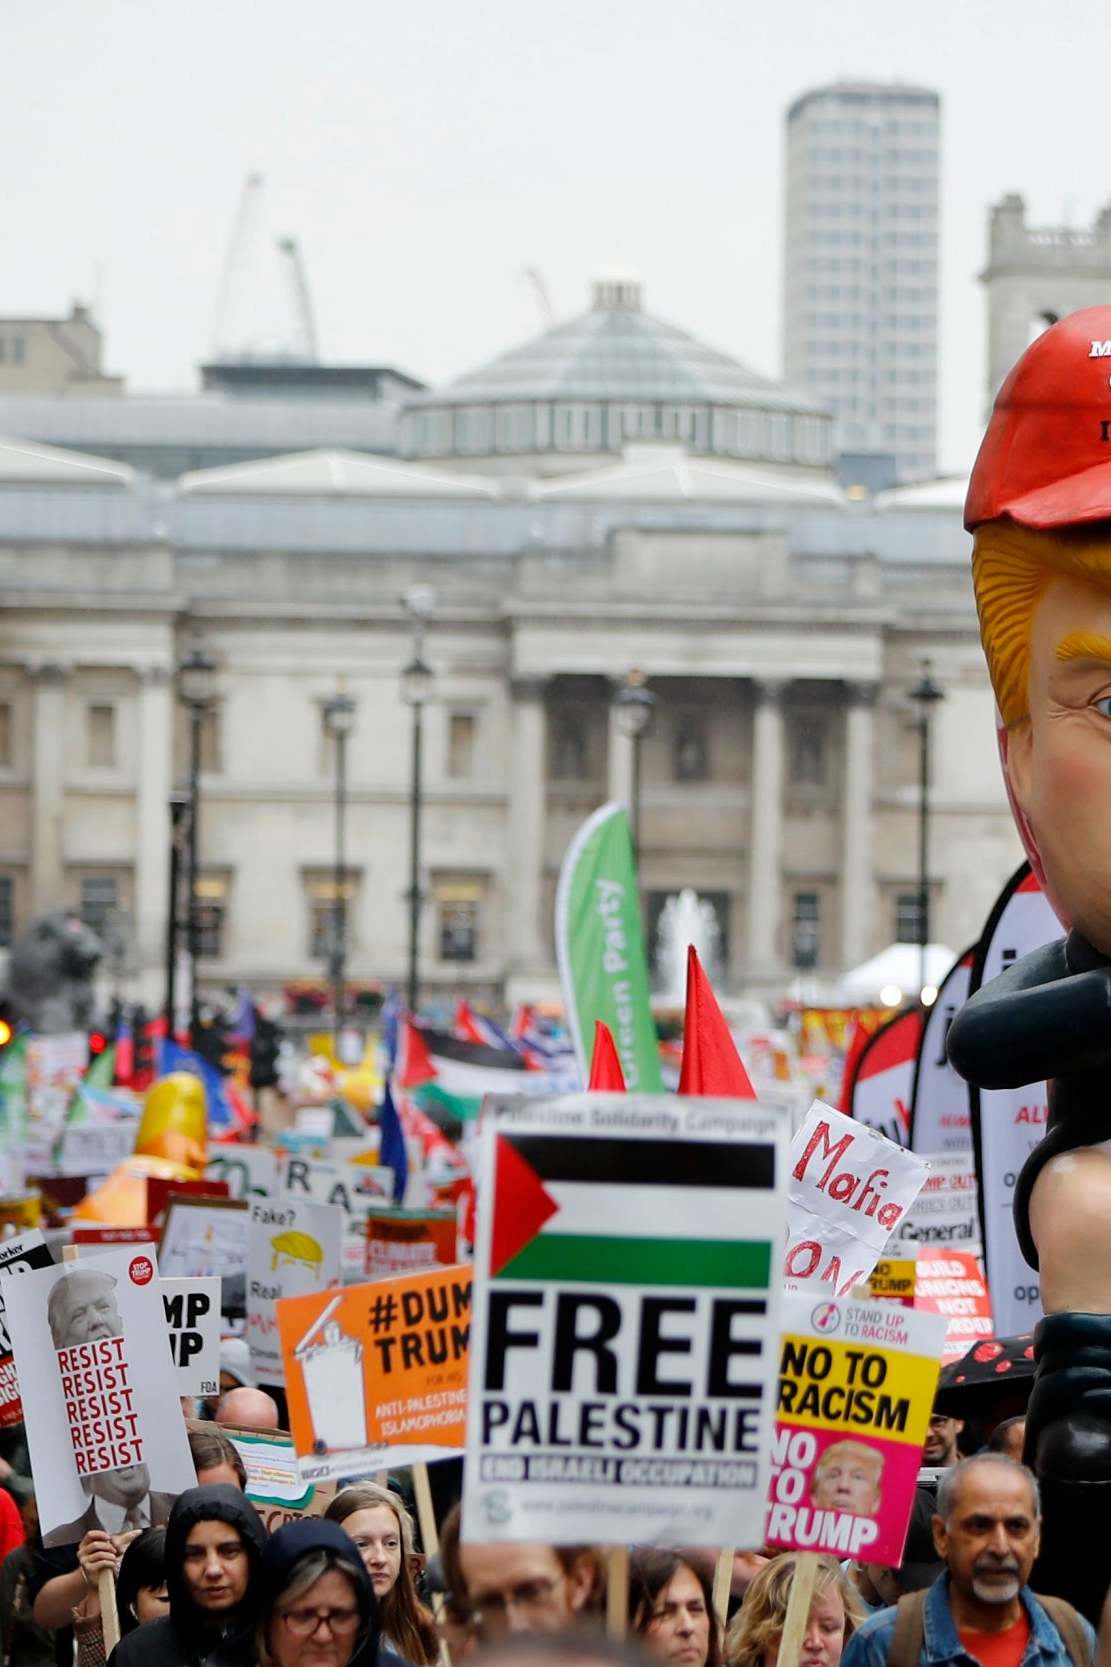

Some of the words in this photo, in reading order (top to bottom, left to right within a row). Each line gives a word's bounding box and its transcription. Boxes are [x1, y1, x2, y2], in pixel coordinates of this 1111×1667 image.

[597, 878, 627, 974] Party
[590, 1108, 678, 1132] Solidarity
[792, 1119, 903, 1231] Mafia
[252, 1204, 296, 1227] Fake?
[900, 1217, 975, 1243] General
[846, 1308, 882, 1325] STAND
[885, 1314, 905, 1328] UP
[936, 1297, 976, 1317] NOT
[483, 1290, 767, 1398] FREE
[845, 1324, 860, 1337] TO
[861, 1325, 909, 1345] RACISM
[57, 1337, 125, 1374] RESIST
[780, 1341, 833, 1381] NO
[845, 1351, 888, 1389] TO
[62, 1363, 129, 1399] RESIST
[66, 1388, 133, 1425] RESIST
[776, 1378, 911, 1432] RACISM
[70, 1414, 138, 1449] RESIST
[481, 1400, 761, 1453] PALESTINE
[75, 1439, 143, 1475] RESIST
[482, 1457, 524, 1478] END
[529, 1459, 614, 1481] ISRAELI
[621, 1461, 754, 1484] OCCUPATION
